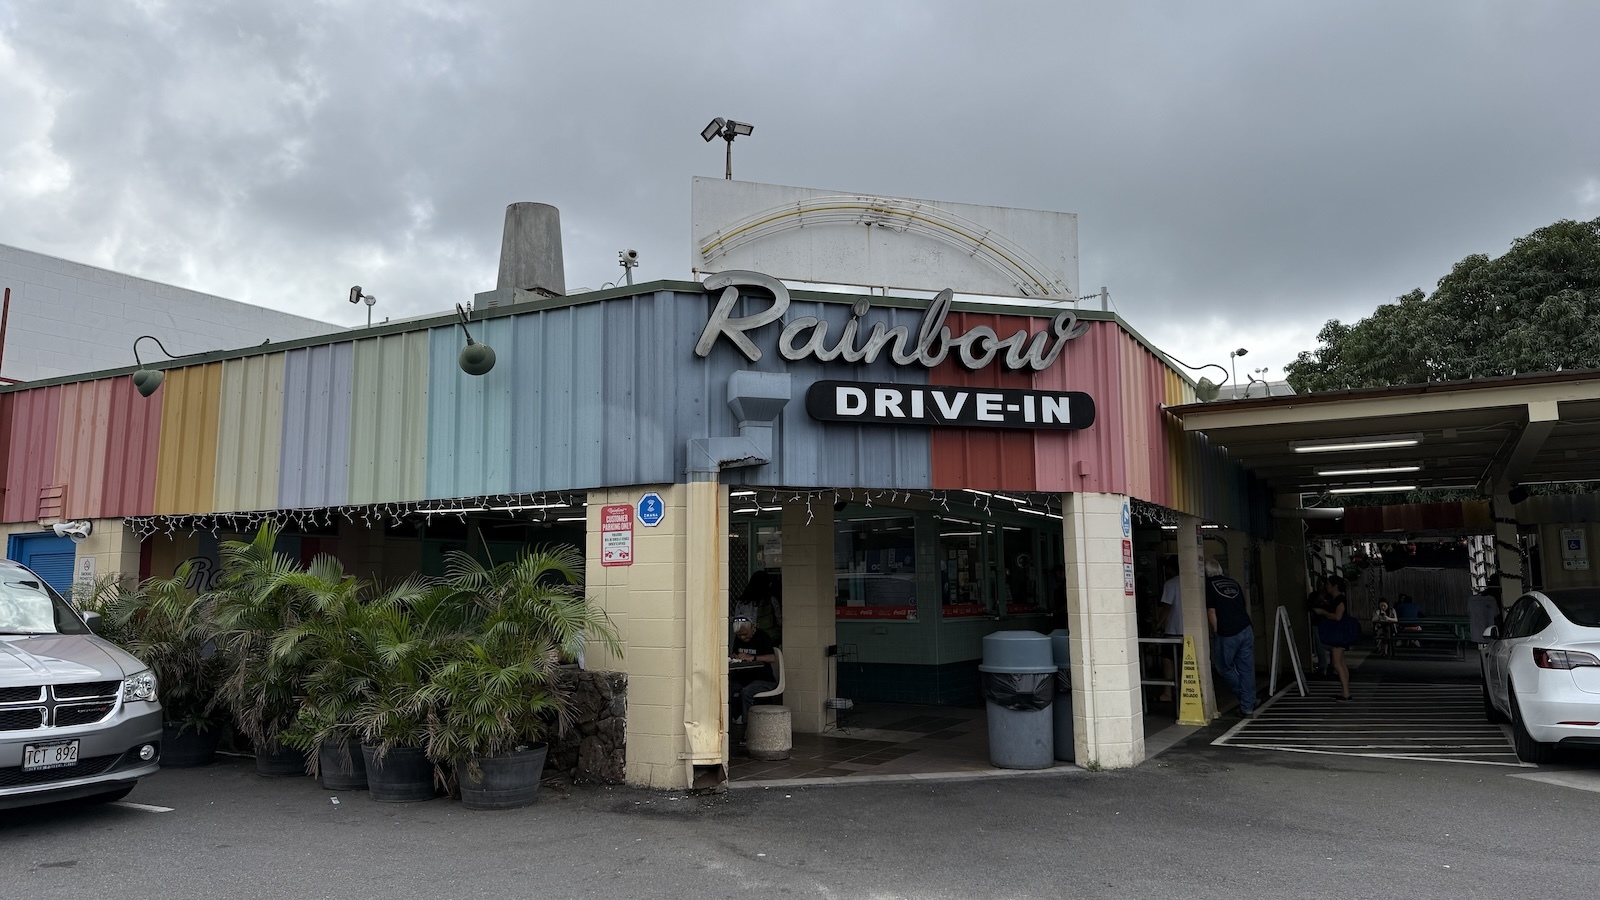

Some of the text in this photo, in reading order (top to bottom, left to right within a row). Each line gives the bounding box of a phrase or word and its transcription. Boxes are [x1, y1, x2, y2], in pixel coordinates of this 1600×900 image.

[694, 269, 1091, 371] Rainbow
[834, 385, 1072, 424] DRIVE-IN
[603, 522, 632, 531] PARKING ONLY
[606, 515, 628, 523] CUSTOMER
[27, 746, 77, 765] TCT 892
